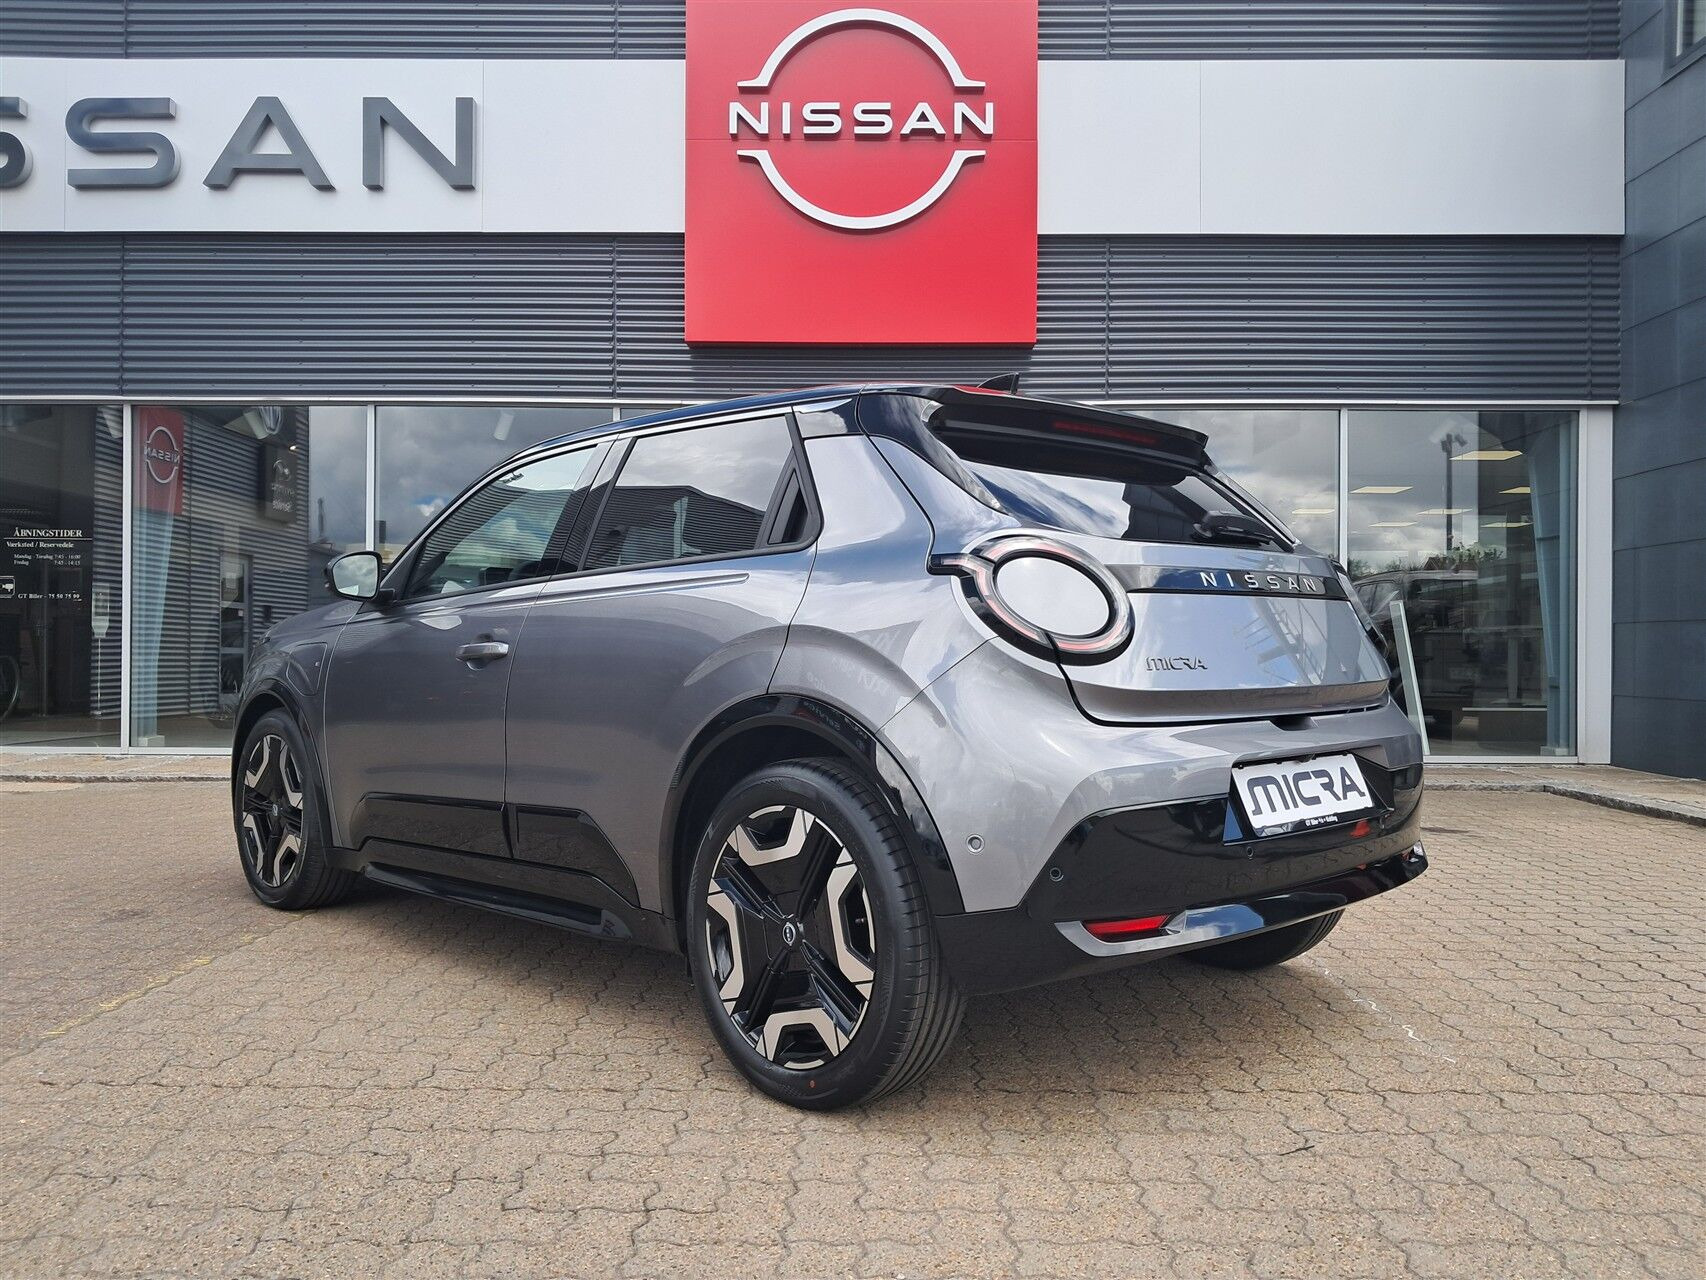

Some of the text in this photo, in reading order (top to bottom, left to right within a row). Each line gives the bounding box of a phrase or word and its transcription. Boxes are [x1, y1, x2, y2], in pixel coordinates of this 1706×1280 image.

[728, 101, 994, 137] NISSAN
[0, 96, 476, 190] SAN
[13, 527, 83, 537] ÅBNINGSTIDER
[1199, 571, 1318, 593] NISSAN
[1145, 656, 1208, 672] MICRA
[1247, 766, 1367, 817] MICRA
